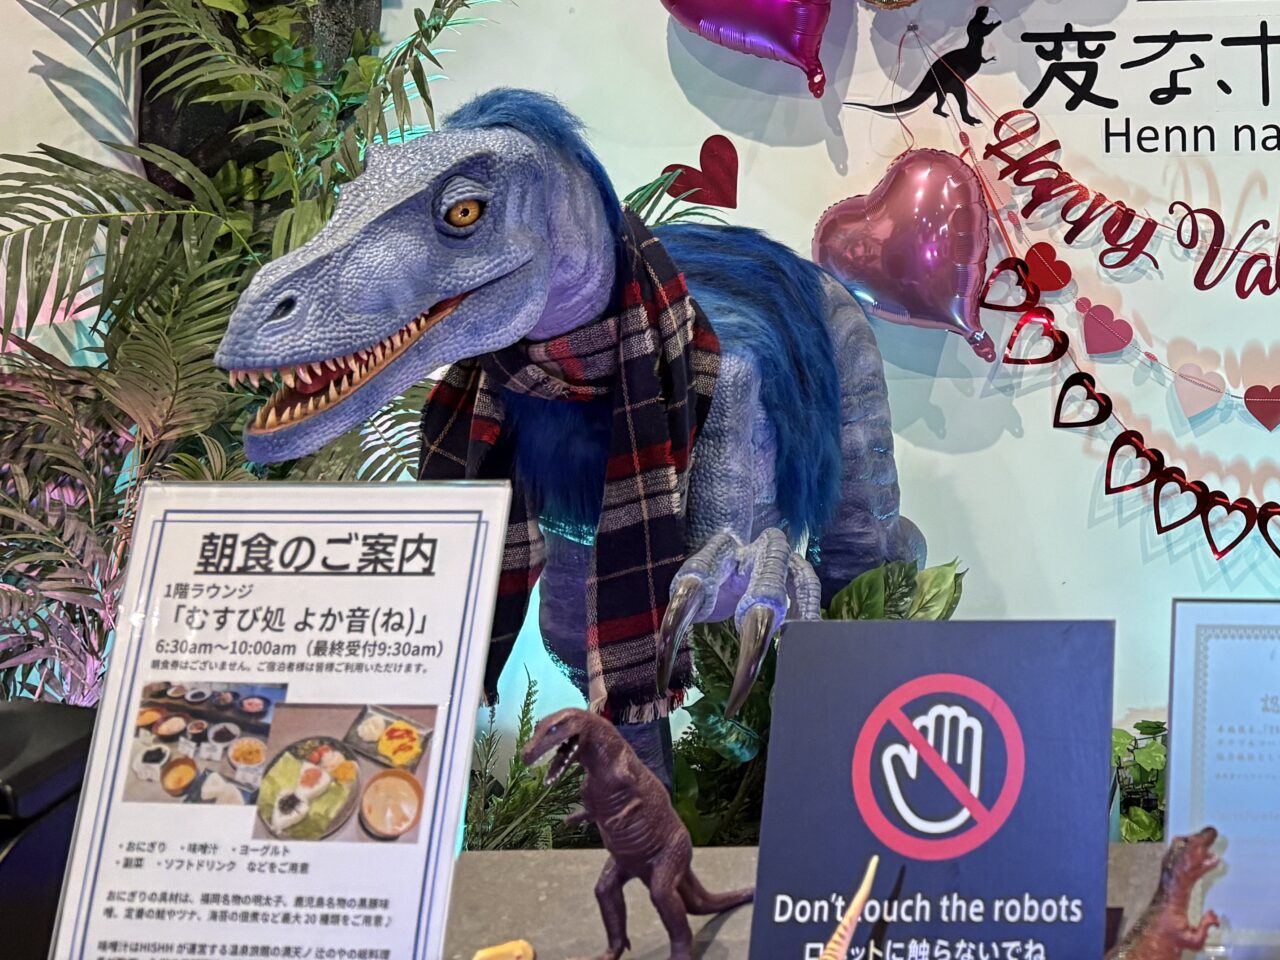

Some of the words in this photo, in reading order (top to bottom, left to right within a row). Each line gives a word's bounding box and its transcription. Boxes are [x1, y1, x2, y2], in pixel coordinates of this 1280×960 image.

[1104, 117, 1215, 153] Henn
[1233, 124, 1280, 151] na
[194, 533, 437, 575] 朝食のご案内
[164, 583, 254, 600] 1階ラウンジ
[172, 606, 285, 633] 「むすび処
[293, 606, 428, 637] よか音(ね)」
[857, 893, 930, 922] ouch
[940, 894, 985, 922] the
[994, 893, 1083, 922] robots
[804, 939, 1046, 960] ロットに触らないでね
